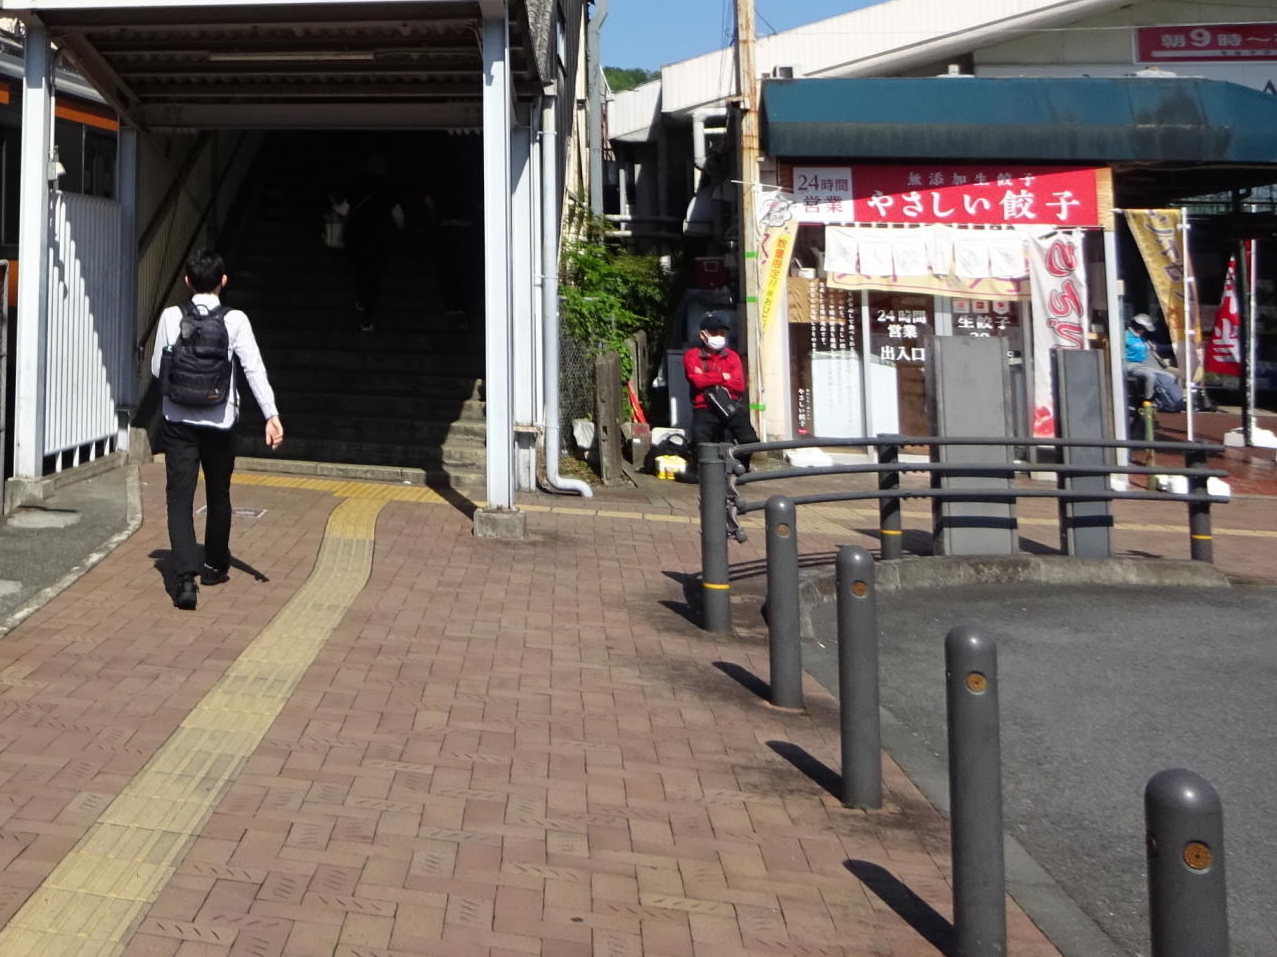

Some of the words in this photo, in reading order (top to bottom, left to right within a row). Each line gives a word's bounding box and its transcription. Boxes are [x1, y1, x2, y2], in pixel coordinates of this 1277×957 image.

[797, 174, 849, 192] 24時間
[908, 170, 1036, 187] 無添加生餃子
[803, 195, 843, 213] 営業
[867, 189, 1080, 220] やさしい餃子
[887, 325, 918, 339] 営業
[880, 345, 925, 361] 出入口
